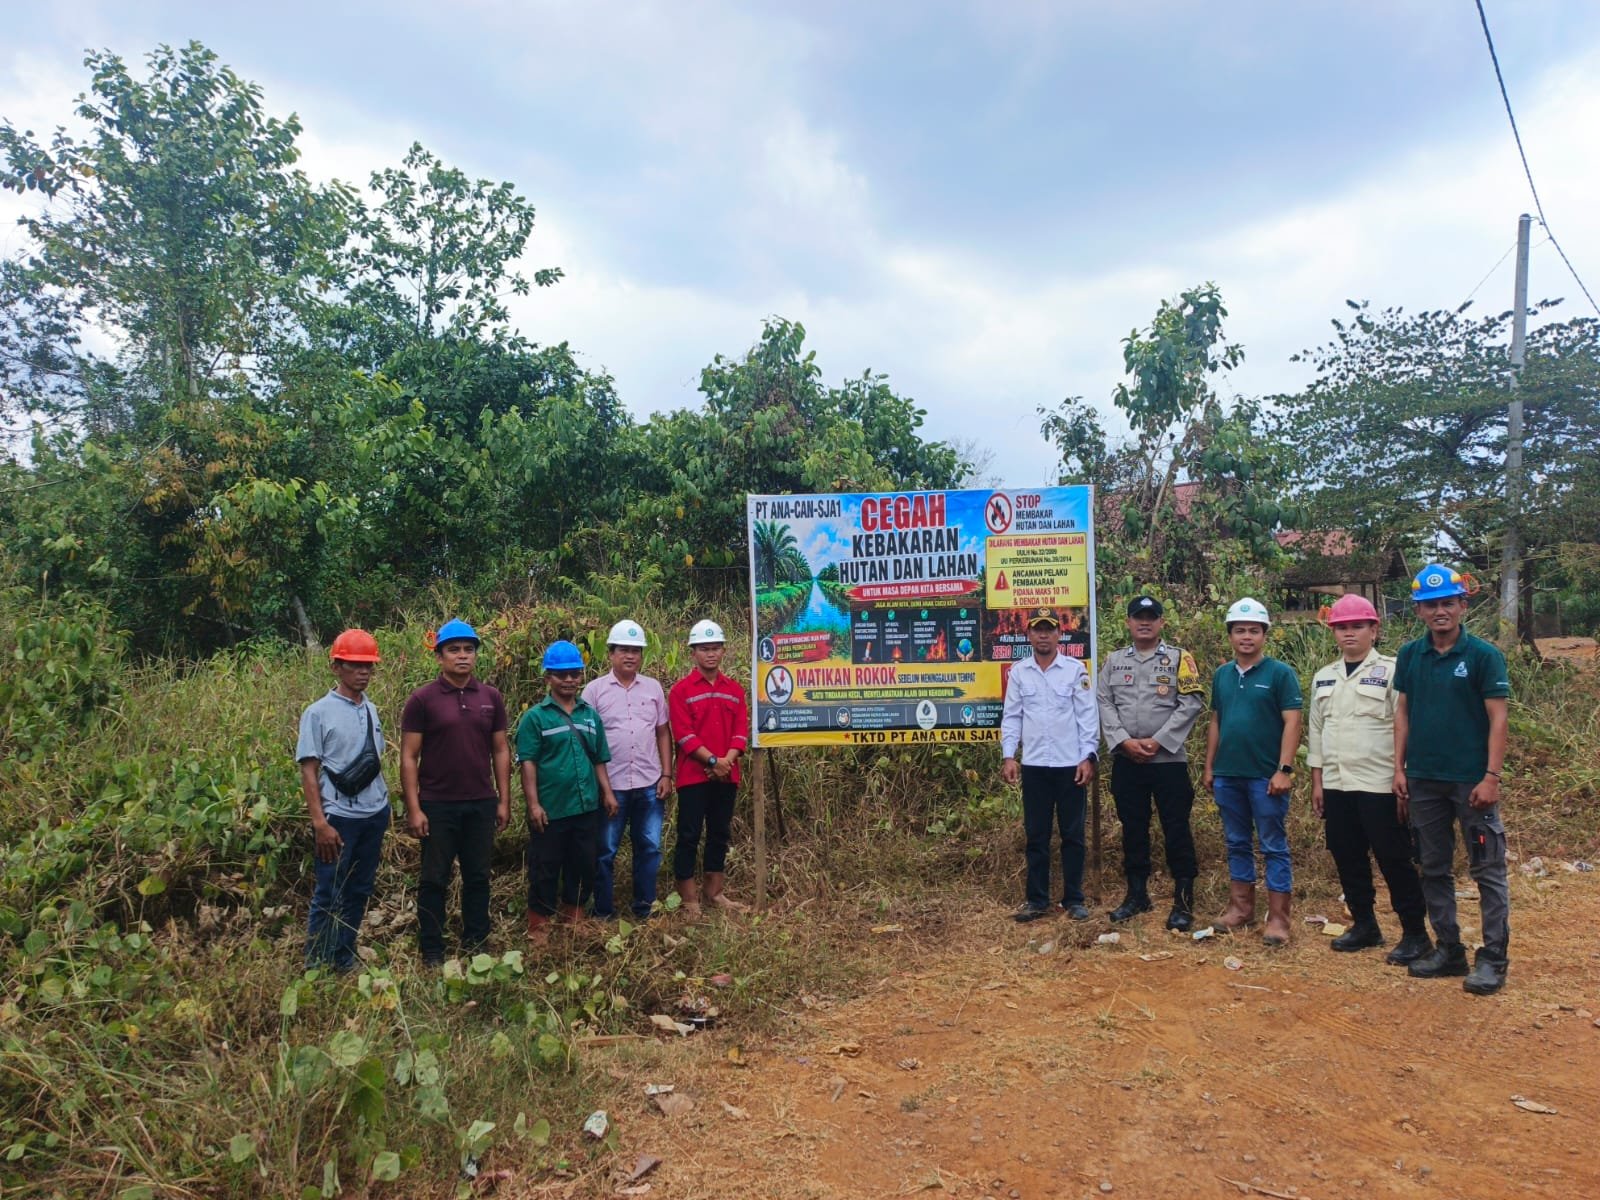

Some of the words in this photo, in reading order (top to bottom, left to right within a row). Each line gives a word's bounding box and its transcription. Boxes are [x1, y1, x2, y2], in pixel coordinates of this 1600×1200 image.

[755, 501, 768, 519] PT
[770, 499, 841, 519] ANA-CAN-SJA1
[1015, 495, 1041, 509] STOP
[861, 494, 946, 532] CEGAH
[1015, 509, 1053, 520] MEMBAKAR
[1015, 521, 1037, 531] HUTAN
[1039, 520, 1052, 530] DAN
[1053, 519, 1075, 529] LAHAN
[852, 528, 959, 558] KEBAKARAN
[839, 559, 889, 584] HUTAN
[893, 557, 923, 581] DAN
[928, 553, 978, 578] LAHAN
[1012, 569, 1043, 578] ANCAMAN
[1044, 568, 1068, 577] PELAKU
[862, 587, 882, 597] UNTUK
[882, 586, 899, 596] MASA
[900, 585, 919, 595] DEPAN
[920, 584, 934, 593] KITA
[934, 582, 964, 592] BERSAMA
[1012, 578, 1055, 587] PEMBAKARAN
[1013, 587, 1034, 596] PIDANA
[1035, 587, 1052, 595] MAKS
[1053, 586, 1060, 595] 10
[1061, 586, 1069, 595] TH
[1019, 597, 1040, 605] DENDA
[1049, 596, 1056, 604] M
[991, 645, 1012, 659] ZERO
[796, 668, 851, 687] MATIKAN
[855, 666, 897, 686] ROKOK
[851, 732, 886, 743] TKTD
[890, 732, 907, 742] PT
[911, 731, 937, 742] ANA
[940, 730, 965, 742] CAN
[970, 730, 999, 741] SJA1
